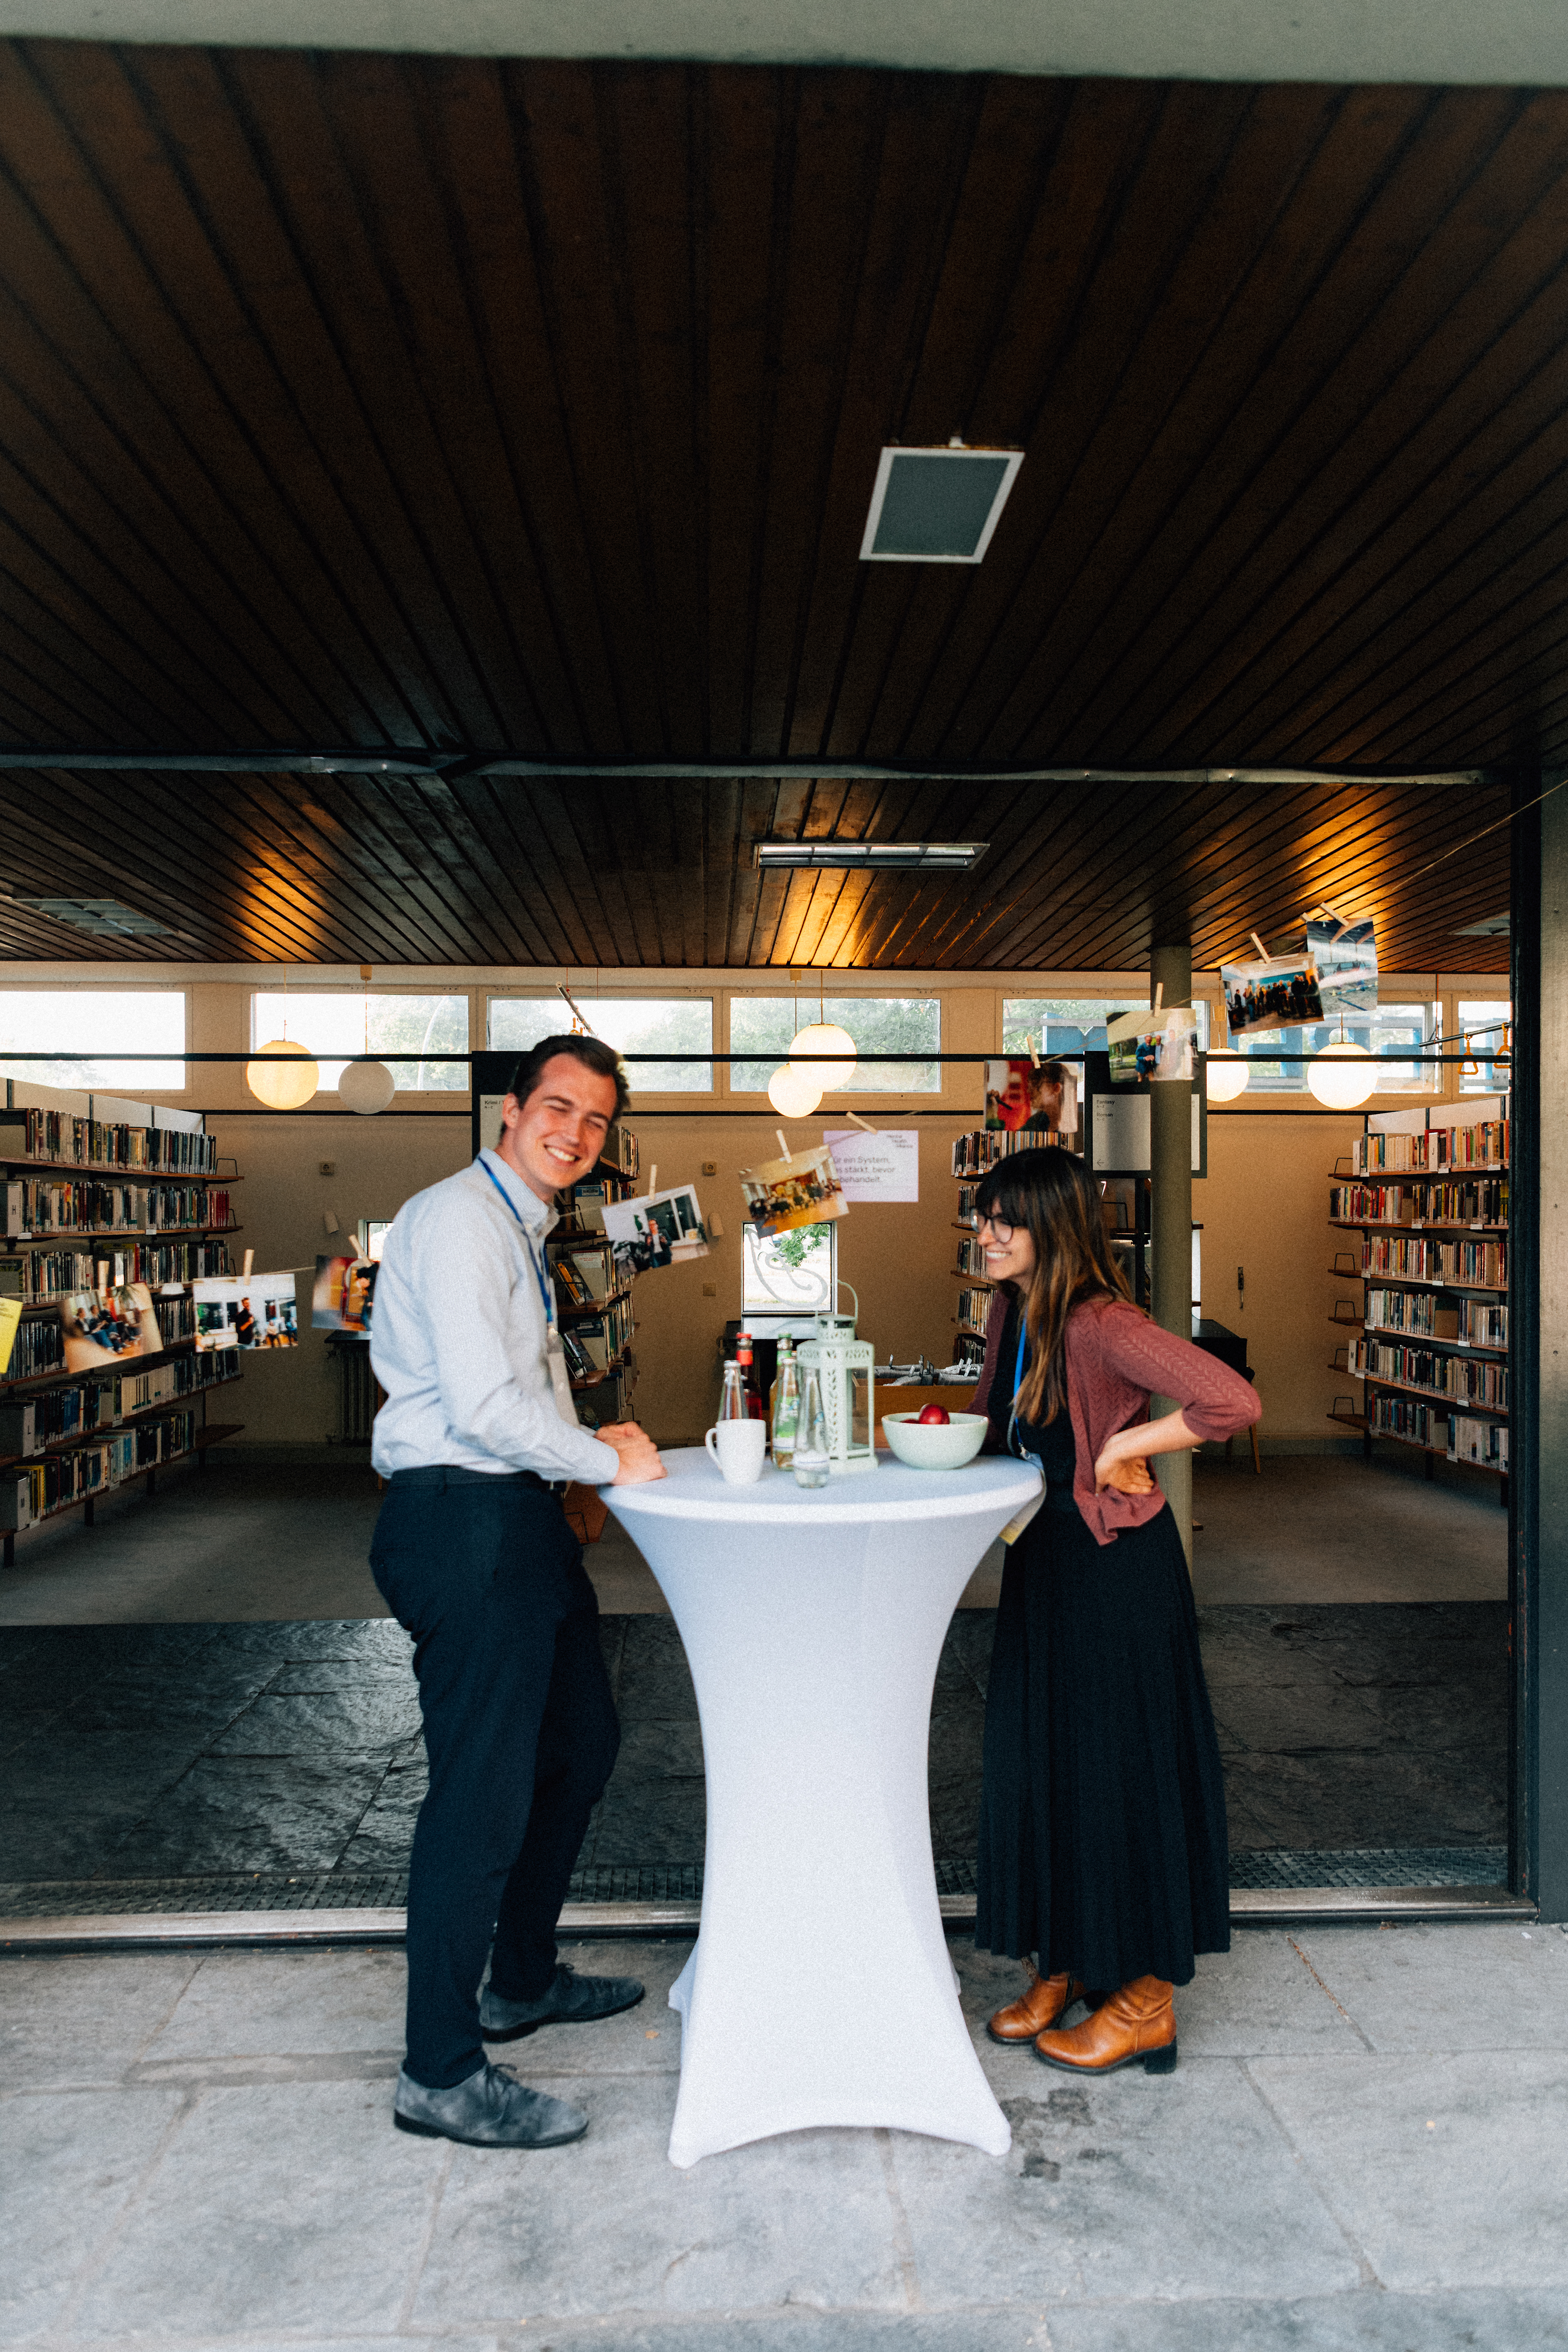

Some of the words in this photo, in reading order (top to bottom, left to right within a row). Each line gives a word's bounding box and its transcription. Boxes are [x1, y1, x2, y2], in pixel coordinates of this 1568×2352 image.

[858, 1156, 890, 1164] System,
[12, 1205, 16, 1215] H
[27, 1425, 31, 1435] L
